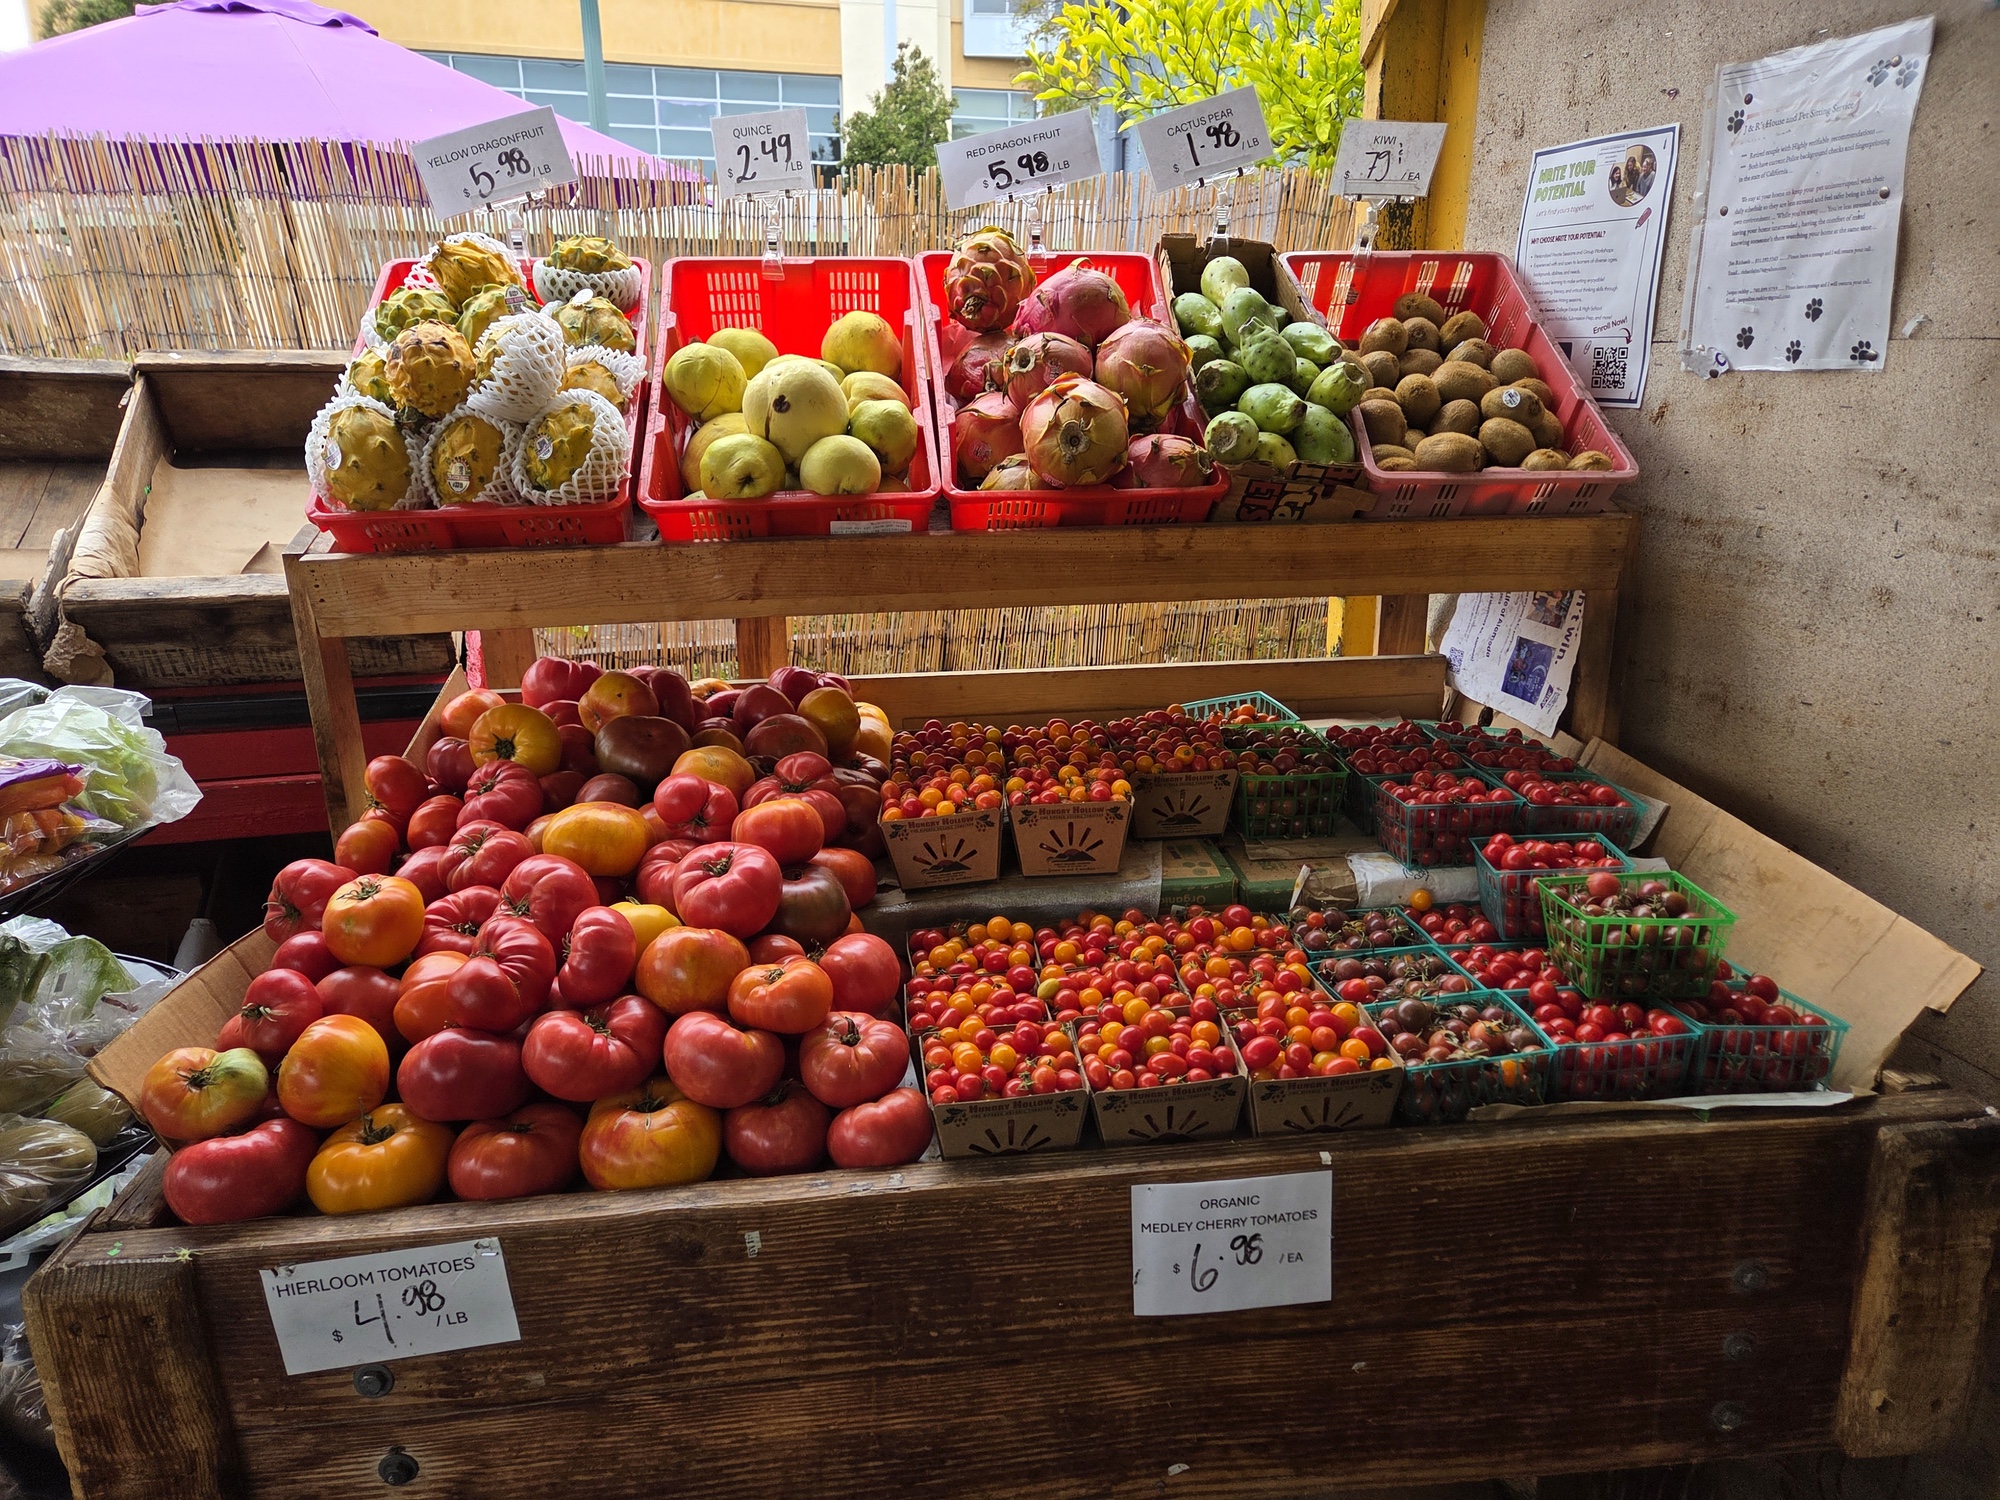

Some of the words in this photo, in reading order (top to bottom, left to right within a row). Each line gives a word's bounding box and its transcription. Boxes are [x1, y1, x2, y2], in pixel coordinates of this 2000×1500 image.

[1167, 117, 1207, 137] CACTUS
[1208, 108, 1234, 123] PEAR
[1766, 118, 1785, 127] House
[1786, 115, 1797, 123] and
[1798, 112, 1809, 121] Pet
[1810, 108, 1830, 119] Sitting
[1832, 102, 1854, 112] Service
[733, 125, 772, 139] QUINCE
[1374, 136, 1397, 144] KIWI
[427, 148, 468, 168] YELLOW
[471, 126, 544, 155] DRAGONFRUIT
[966, 147, 986, 159] RED
[988, 136, 1031, 153] DRAGON
[1033, 128, 1061, 142] FRUIT
[727, 168, 733, 179] $
[983, 180, 989, 189] $
[988, 151, 1049, 190] 5.98
[1173, 164, 1179, 173] $
[1344, 170, 1350, 179] $
[1538, 165, 1567, 184] WRITE
[1569, 160, 1595, 178] YOUR
[1766, 168, 1788, 178] California
[463, 188, 470, 198] $
[1534, 181, 1585, 203] POTENTIAL
[1540, 235, 1555, 244] CHOOSE
[1555, 234, 1567, 242] WRITE
[1568, 233, 1579, 241] YOUR
[1580, 230, 1606, 239] POTENTIAL?
[1593, 321, 1610, 334] Enroll
[1612, 316, 1628, 328] Now!
[1500, 608, 1506, 618] of
[1486, 618, 1503, 658] Alameda
[1555, 626, 1575, 664] win.
[908, 820, 939, 828] HUNGRY
[942, 816, 973, 825] HOLLOW
[969, 1104, 1009, 1113] HUNGRY
[1013, 1099, 1053, 1109] HOLLOW
[1200, 1195, 1261, 1210] ORGANIC
[1141, 1222, 1194, 1233] MEDLEY
[1196, 1217, 1248, 1231] CHERRY
[1250, 1210, 1318, 1226] TOMATOES
[1173, 1263, 1180, 1274] $
[1191, 1233, 1263, 1292] 6.98
[277, 1272, 374, 1297] HIERLOOM
[377, 1257, 475, 1282] TOMATOES
[332, 1329, 343, 1343] $
[355, 1279, 445, 1345] 4.98
